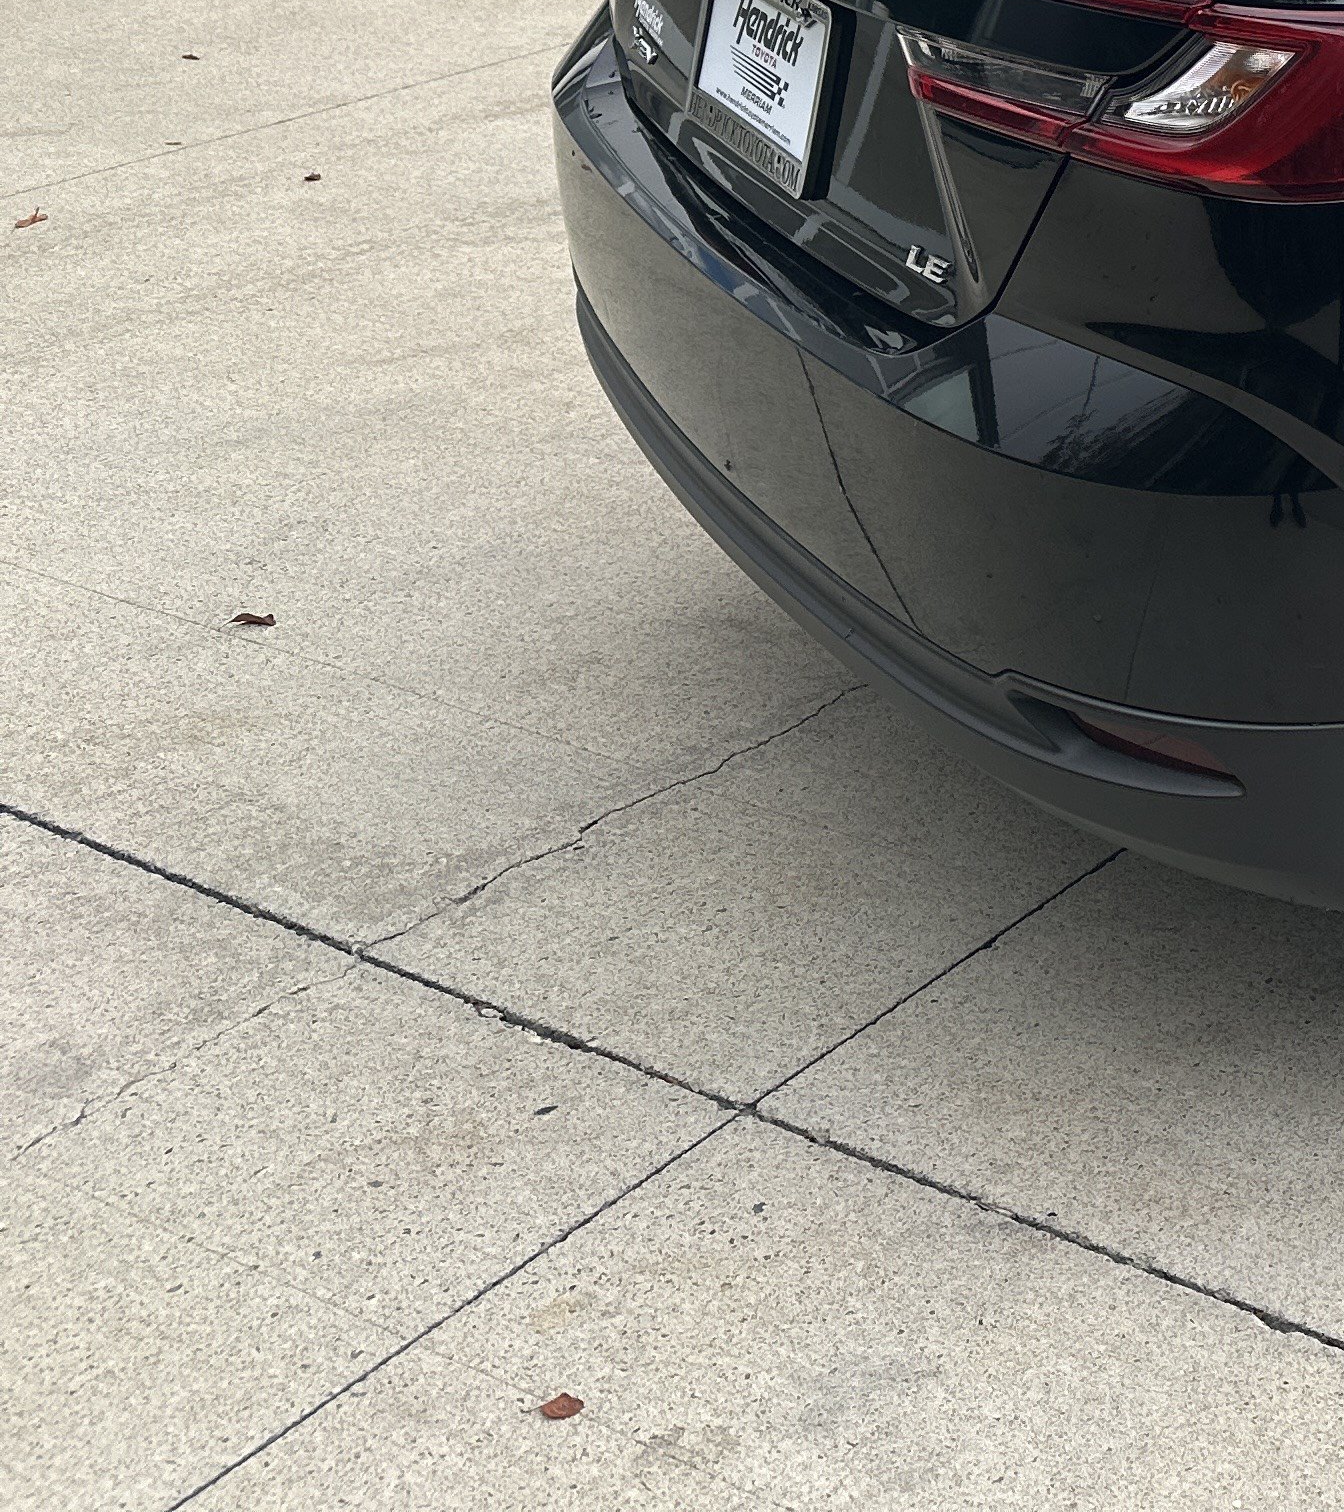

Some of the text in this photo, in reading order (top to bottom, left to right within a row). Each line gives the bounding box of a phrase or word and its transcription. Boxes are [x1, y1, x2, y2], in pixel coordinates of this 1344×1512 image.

[751, 44, 777, 69] TOYOTA
[740, 86, 773, 115] MERRIAM
[905, 244, 951, 284] LE
